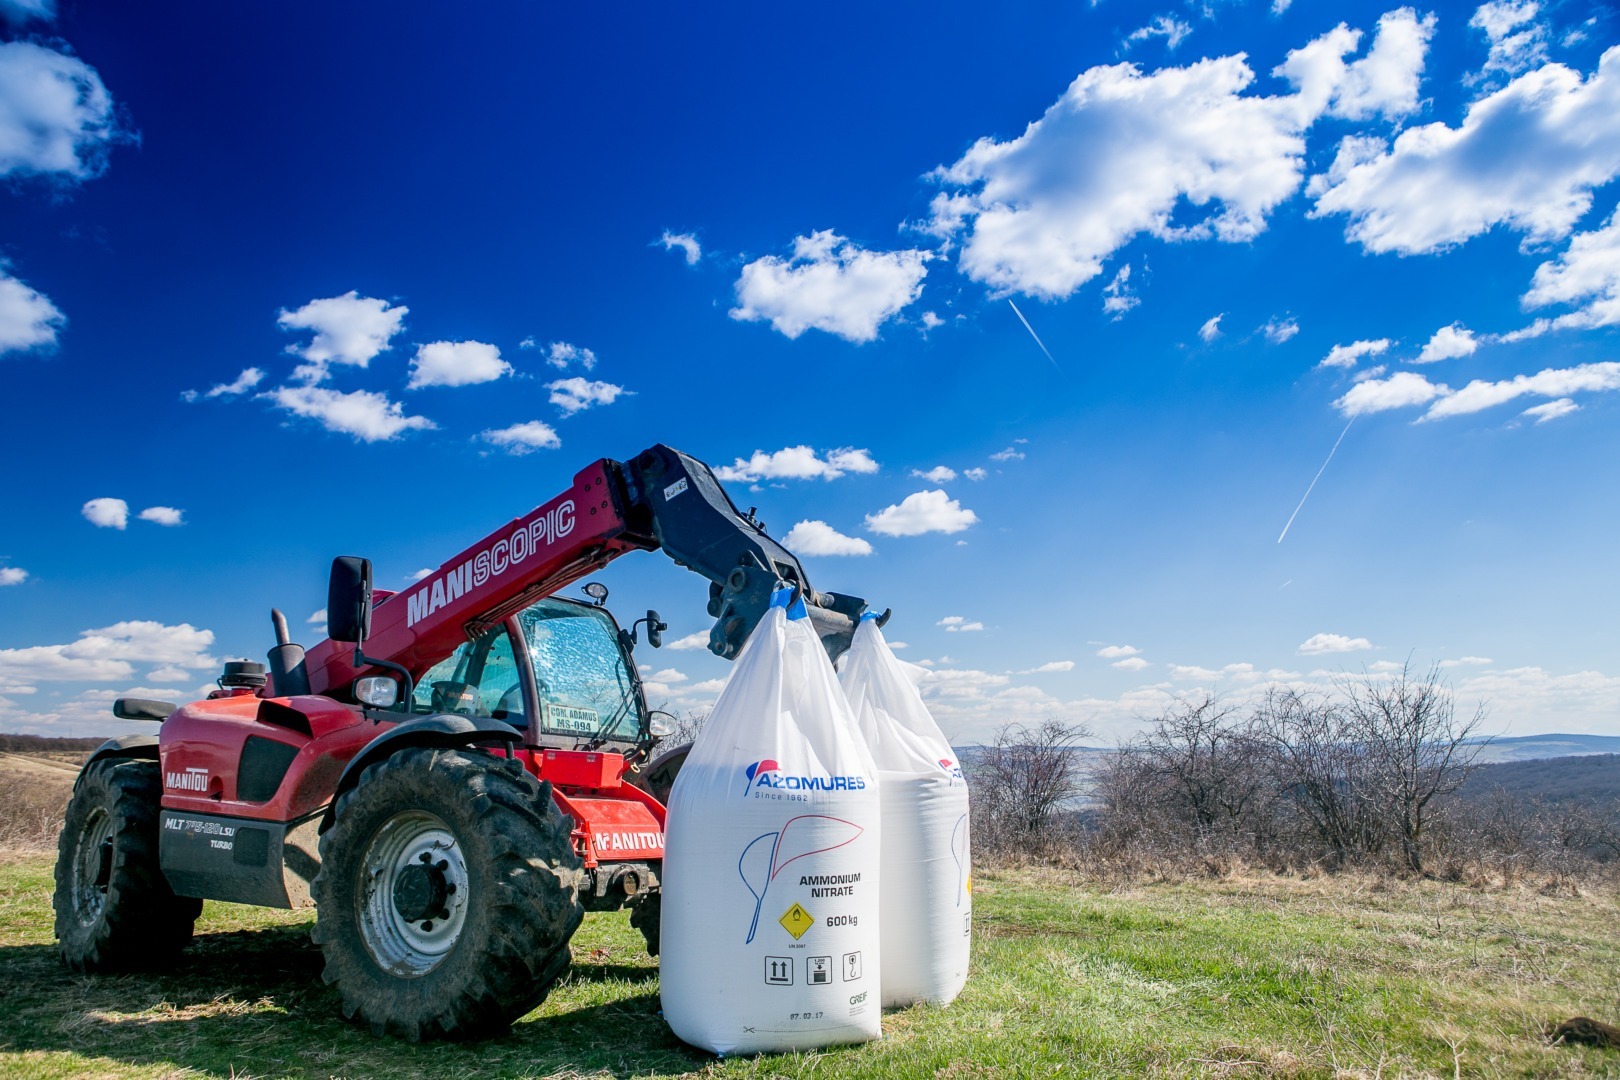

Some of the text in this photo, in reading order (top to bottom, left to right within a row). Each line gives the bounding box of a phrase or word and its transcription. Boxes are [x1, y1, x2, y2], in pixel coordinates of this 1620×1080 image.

[407, 500, 576, 628] MANISCOPIC
[569, 709, 597, 722] ADAMUS
[556, 718, 592, 732] MS-094
[166, 767, 209, 792] MANITOU
[756, 773, 866, 791] AZOMURES
[754, 791, 808, 802] Since 1962
[164, 818, 185, 830] MLT
[219, 826, 235, 837] LSU
[210, 839, 233, 850] TURBO
[799, 872, 861, 886] AMMONIUM
[811, 885, 854, 898] NITRATE
[826, 915, 847, 927] 600
[849, 990, 868, 1005] GREIF
